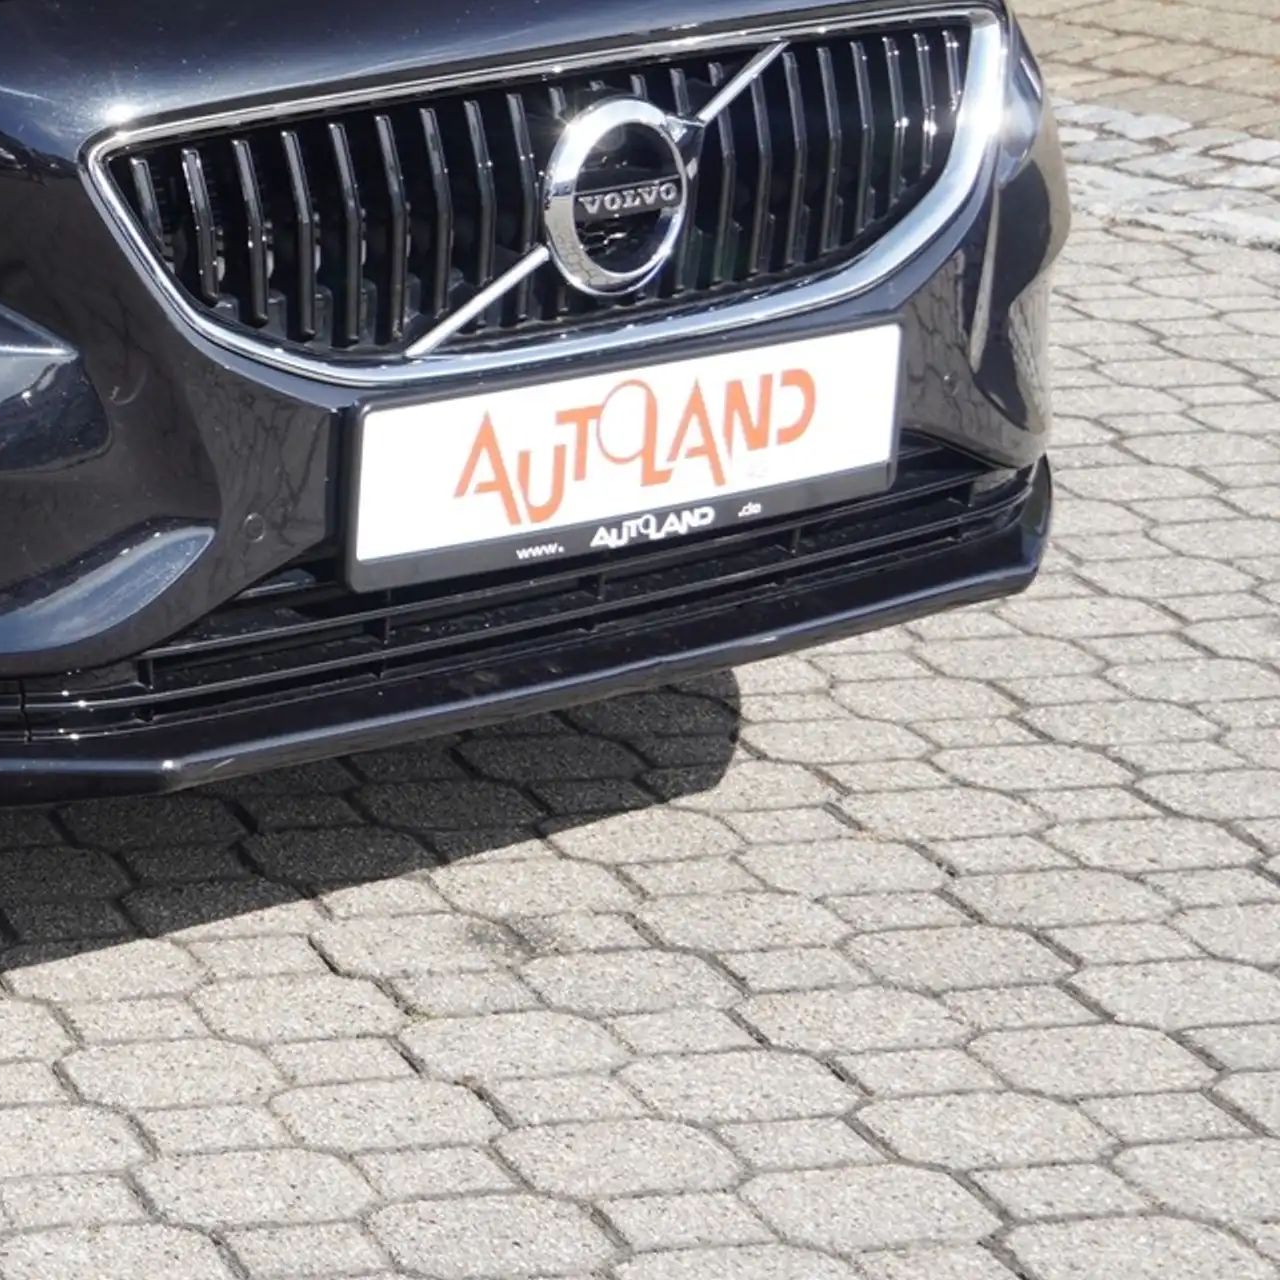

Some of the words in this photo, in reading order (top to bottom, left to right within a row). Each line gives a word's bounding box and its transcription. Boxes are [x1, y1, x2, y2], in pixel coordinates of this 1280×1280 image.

[578, 181, 678, 215] VOLVO
[453, 367, 818, 526] AUTOLAND
[515, 541, 565, 561] www.
[589, 505, 716, 550] AUTOLAND
[738, 500, 763, 519] .de
